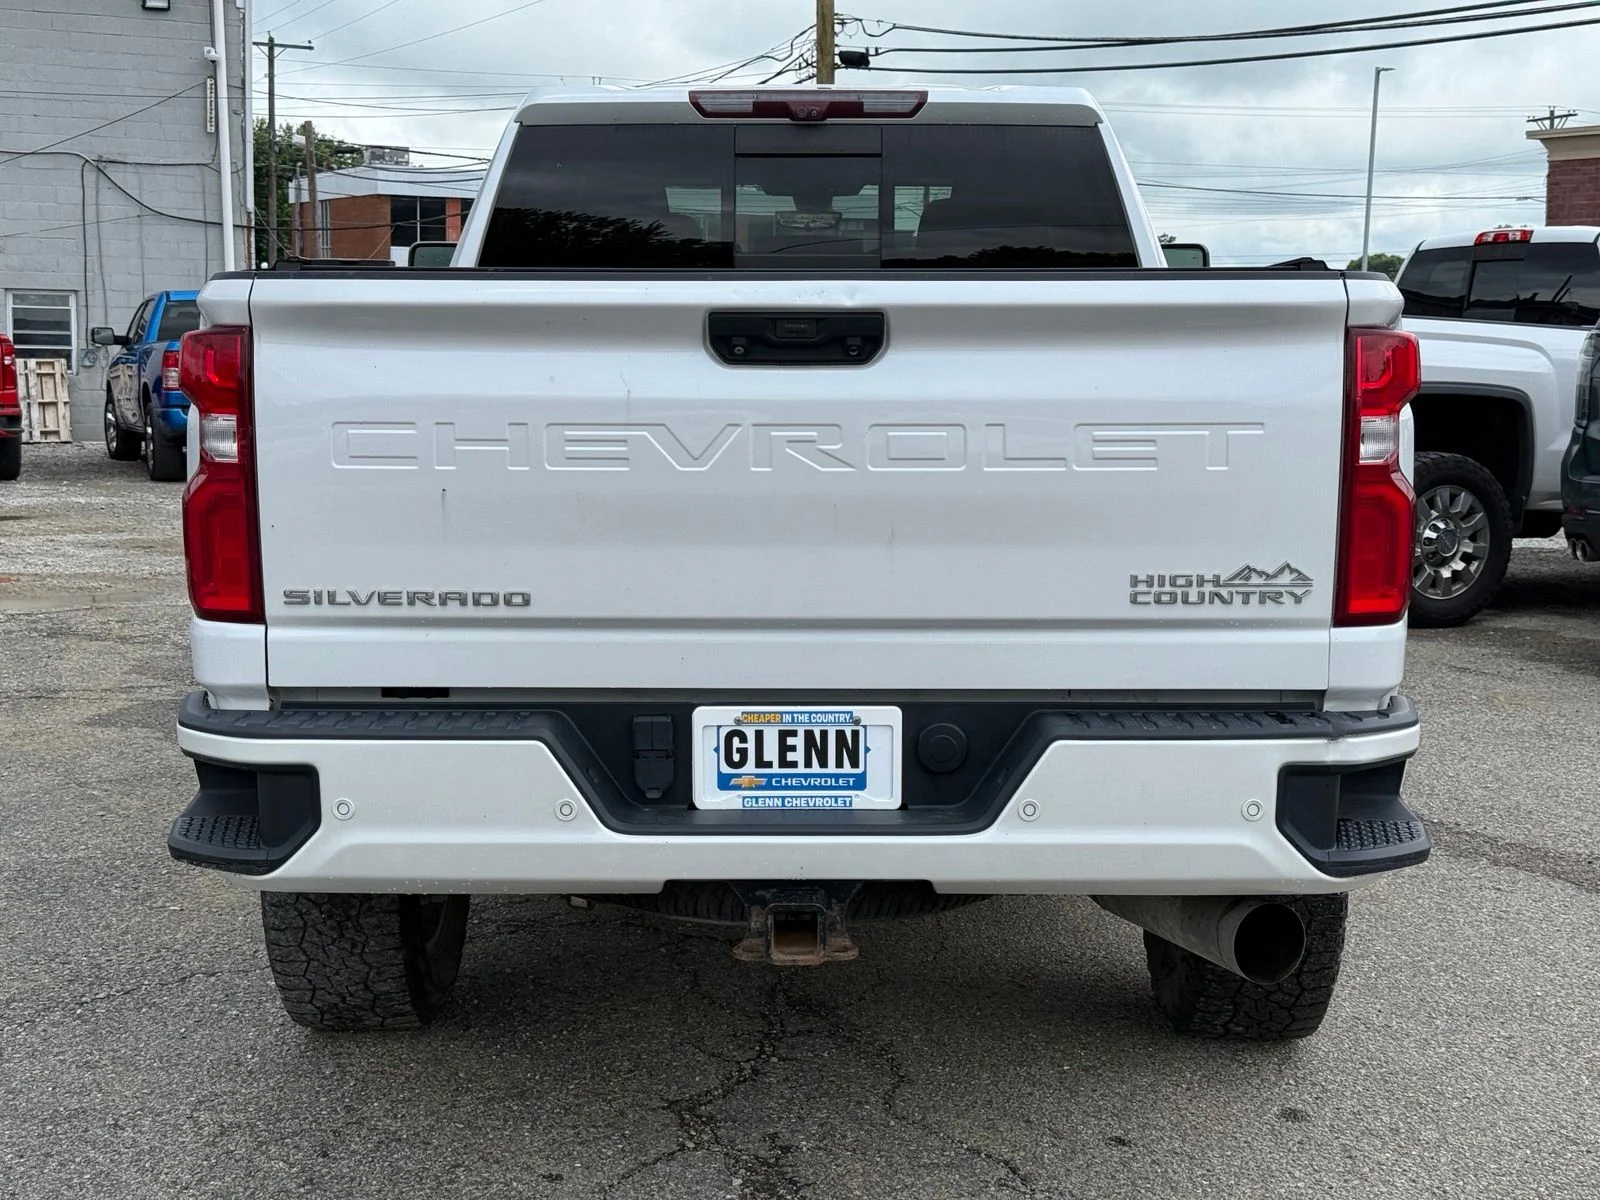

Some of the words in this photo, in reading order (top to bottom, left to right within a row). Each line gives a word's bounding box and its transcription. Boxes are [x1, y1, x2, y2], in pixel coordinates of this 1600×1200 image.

[331, 422, 1265, 473] CHEVROLET
[1129, 574, 1222, 588] HIGH
[283, 589, 532, 607] SILVERADO
[1129, 590, 1312, 605] COUNTRY
[742, 713, 781, 723] CHEAPER
[783, 713, 793, 723] IN
[794, 713, 810, 723] THE
[724, 729, 860, 770] GLENN
[772, 777, 856, 787] CHEVROLET
[743, 797, 782, 808] GLENN
[785, 797, 852, 808] CHEVROLET
